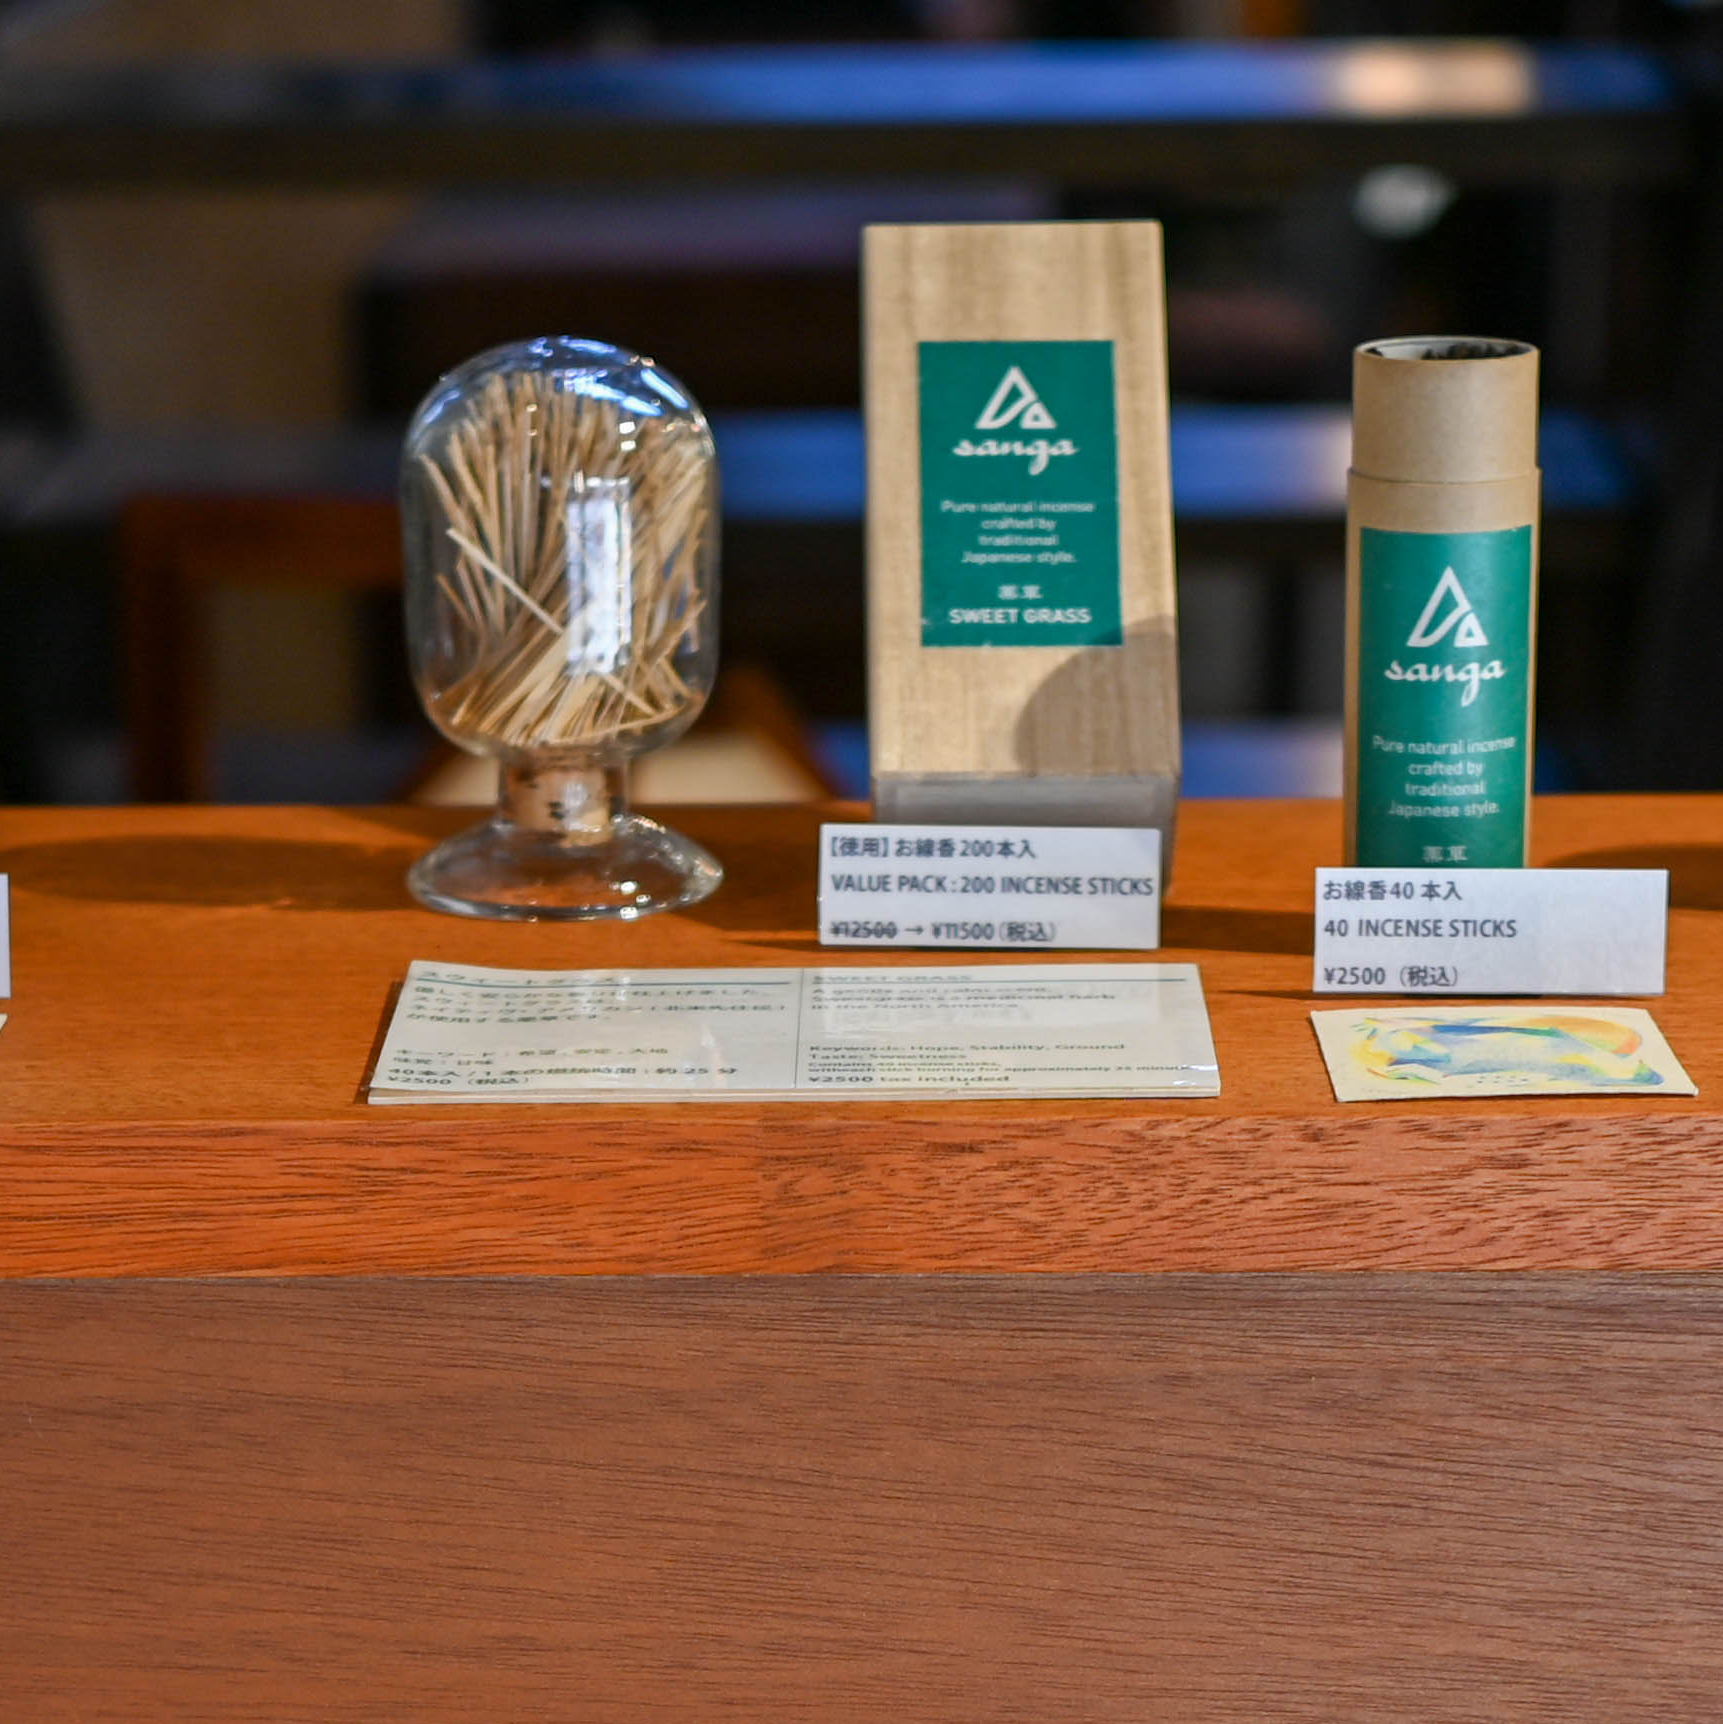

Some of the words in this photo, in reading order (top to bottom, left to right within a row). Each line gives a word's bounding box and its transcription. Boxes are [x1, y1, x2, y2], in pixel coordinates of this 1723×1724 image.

[953, 439, 1077, 475] sanga
[949, 608, 1018, 624] SWEET
[1023, 608, 1092, 624] GRASS
[1385, 660, 1505, 707] sanga
[1324, 919, 1348, 937] 40
[1358, 919, 1443, 937] INCENSE
[1449, 919, 1517, 938] STICKS
[1324, 967, 1385, 985] ¥2500
